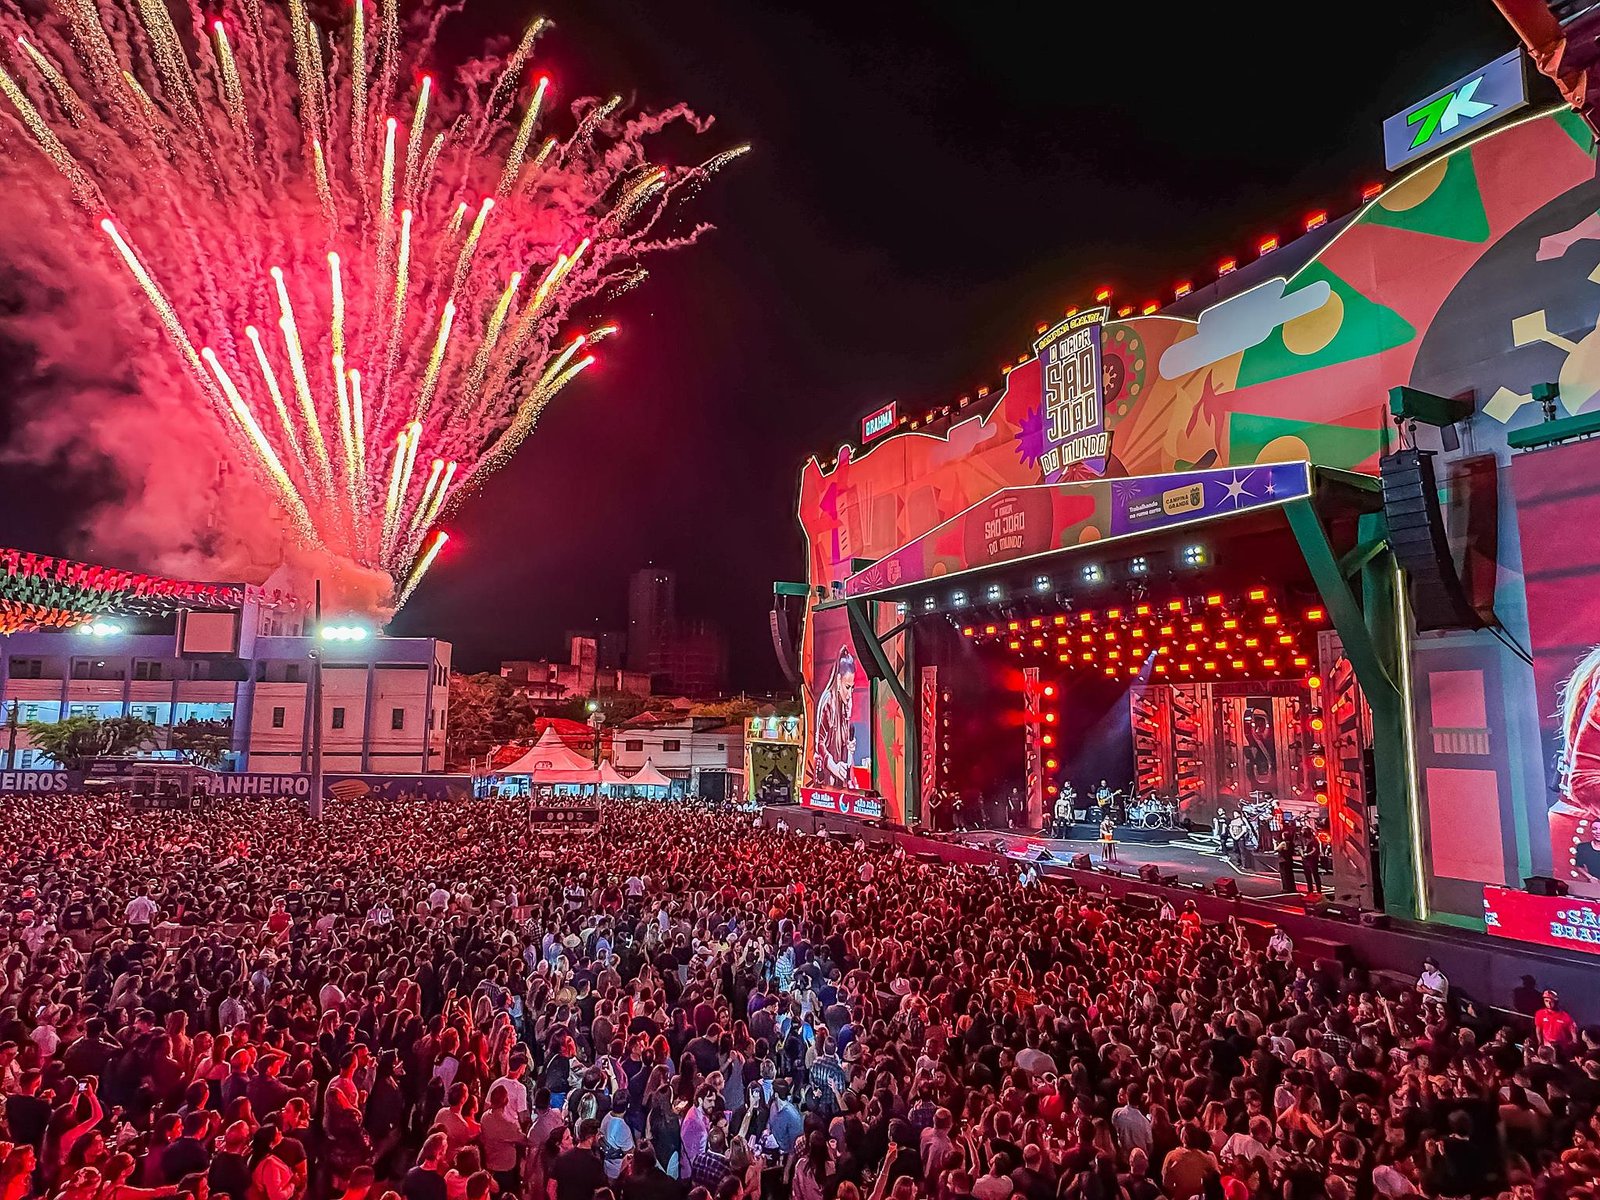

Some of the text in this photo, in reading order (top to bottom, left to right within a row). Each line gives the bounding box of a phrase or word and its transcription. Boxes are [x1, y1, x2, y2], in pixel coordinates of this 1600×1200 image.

[1407, 75, 1495, 150] 7K
[1039, 313, 1100, 350] CAMPINA GRANDE
[1049, 328, 1091, 364] O MAIOR
[1046, 344, 1097, 409] SÃO
[1047, 391, 1099, 442] JOÃO
[1040, 432, 1108, 476] DO MUNDO
[1165, 494, 1189, 505] CAMPINA
[1168, 500, 1190, 509] GRANDE
[1002, 511, 1025, 534] JOÃO
[999, 535, 1022, 550] MUNDO
[2, 772, 69, 792] EIROS
[1566, 906, 1600, 928] SÃ
